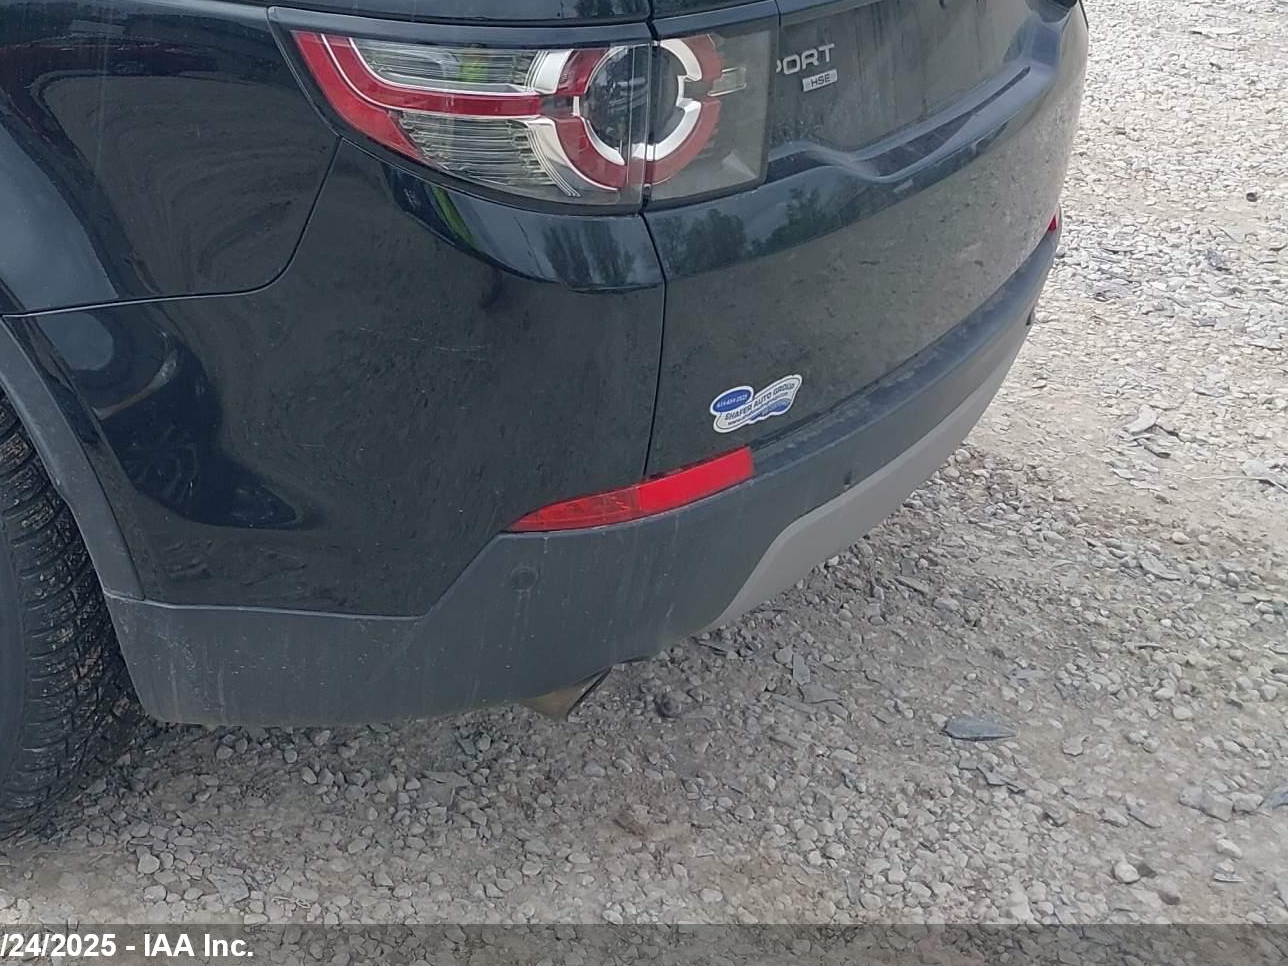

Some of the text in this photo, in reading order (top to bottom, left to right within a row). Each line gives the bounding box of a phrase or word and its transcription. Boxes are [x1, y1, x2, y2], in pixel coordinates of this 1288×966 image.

[810, 73, 832, 87] HSE
[725, 405, 752, 421] SHAFER
[753, 391, 773, 409] AUTO
[772, 382, 795, 396] GROUP
